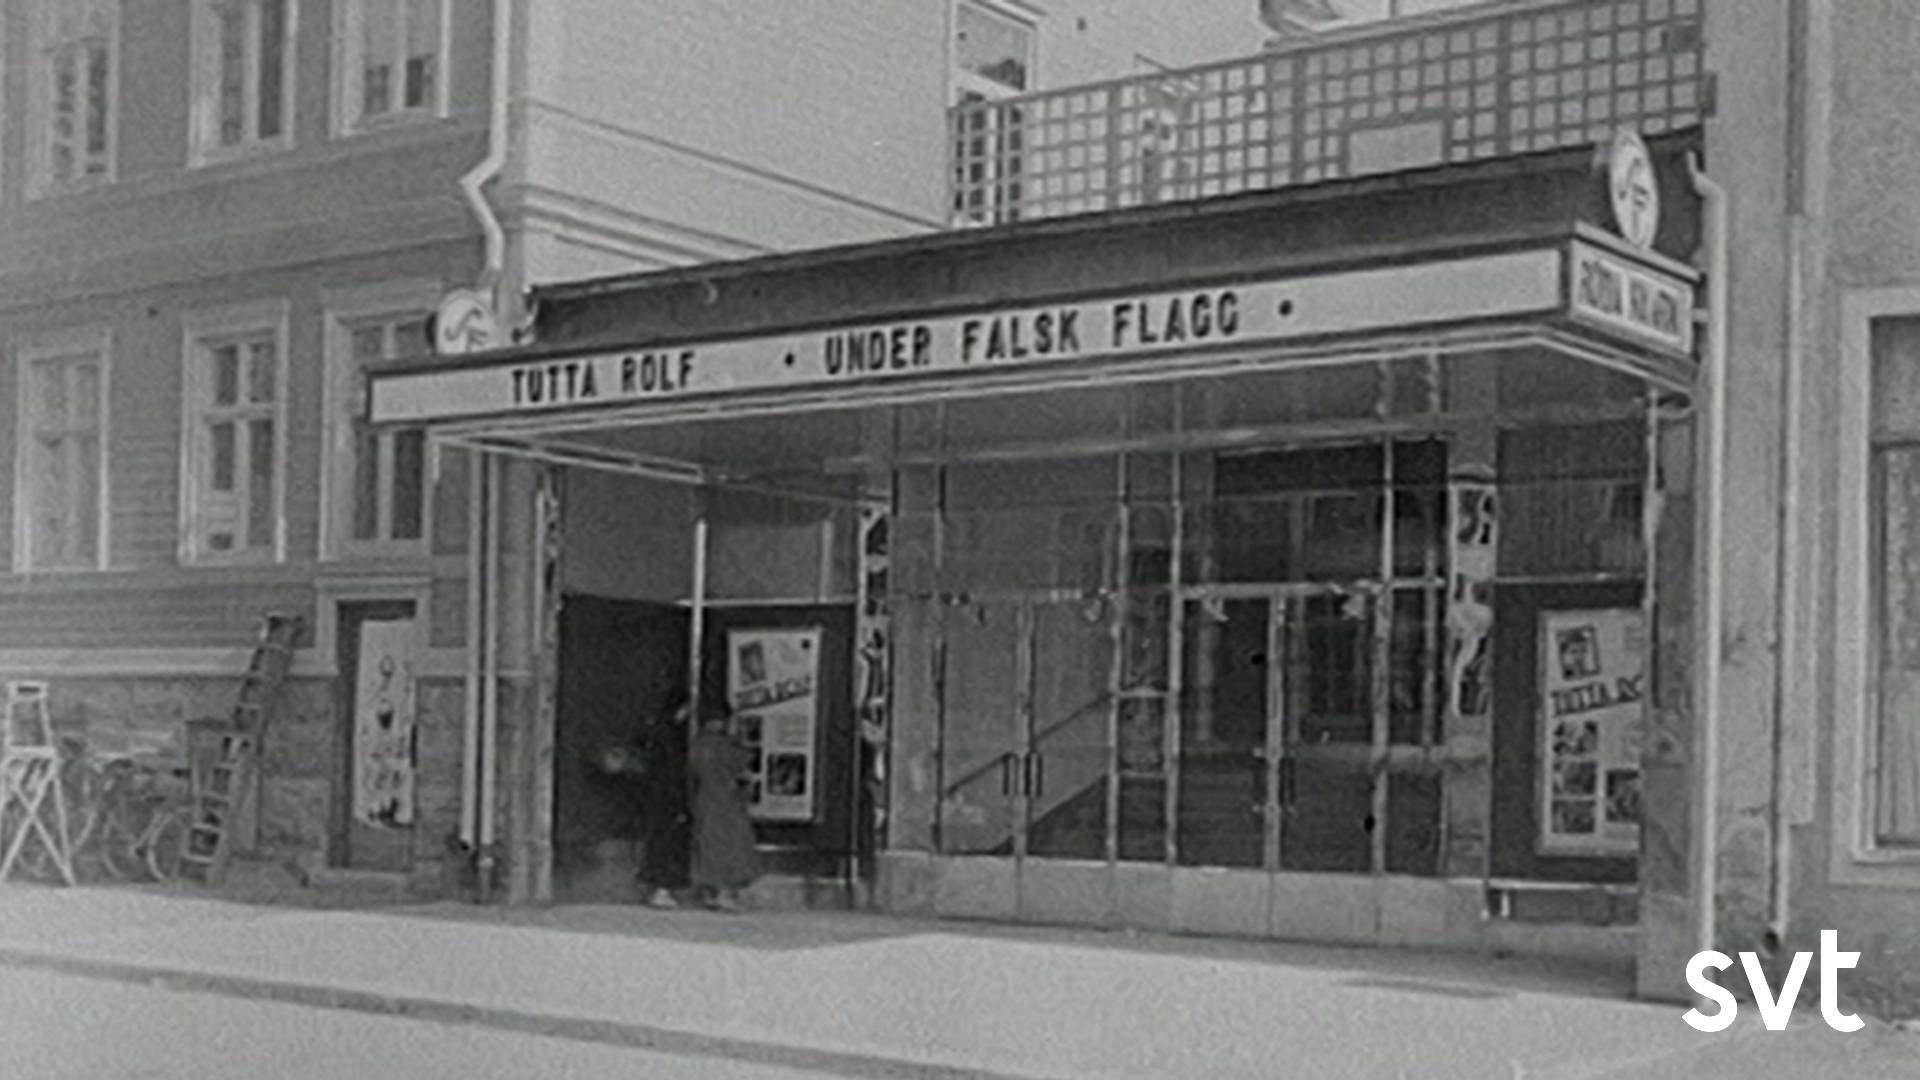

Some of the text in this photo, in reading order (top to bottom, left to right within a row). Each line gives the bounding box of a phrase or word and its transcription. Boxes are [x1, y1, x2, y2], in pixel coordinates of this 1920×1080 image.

[512, 292, 1238, 403] TUTTA ROLF UNDER FALSK FLAGG
